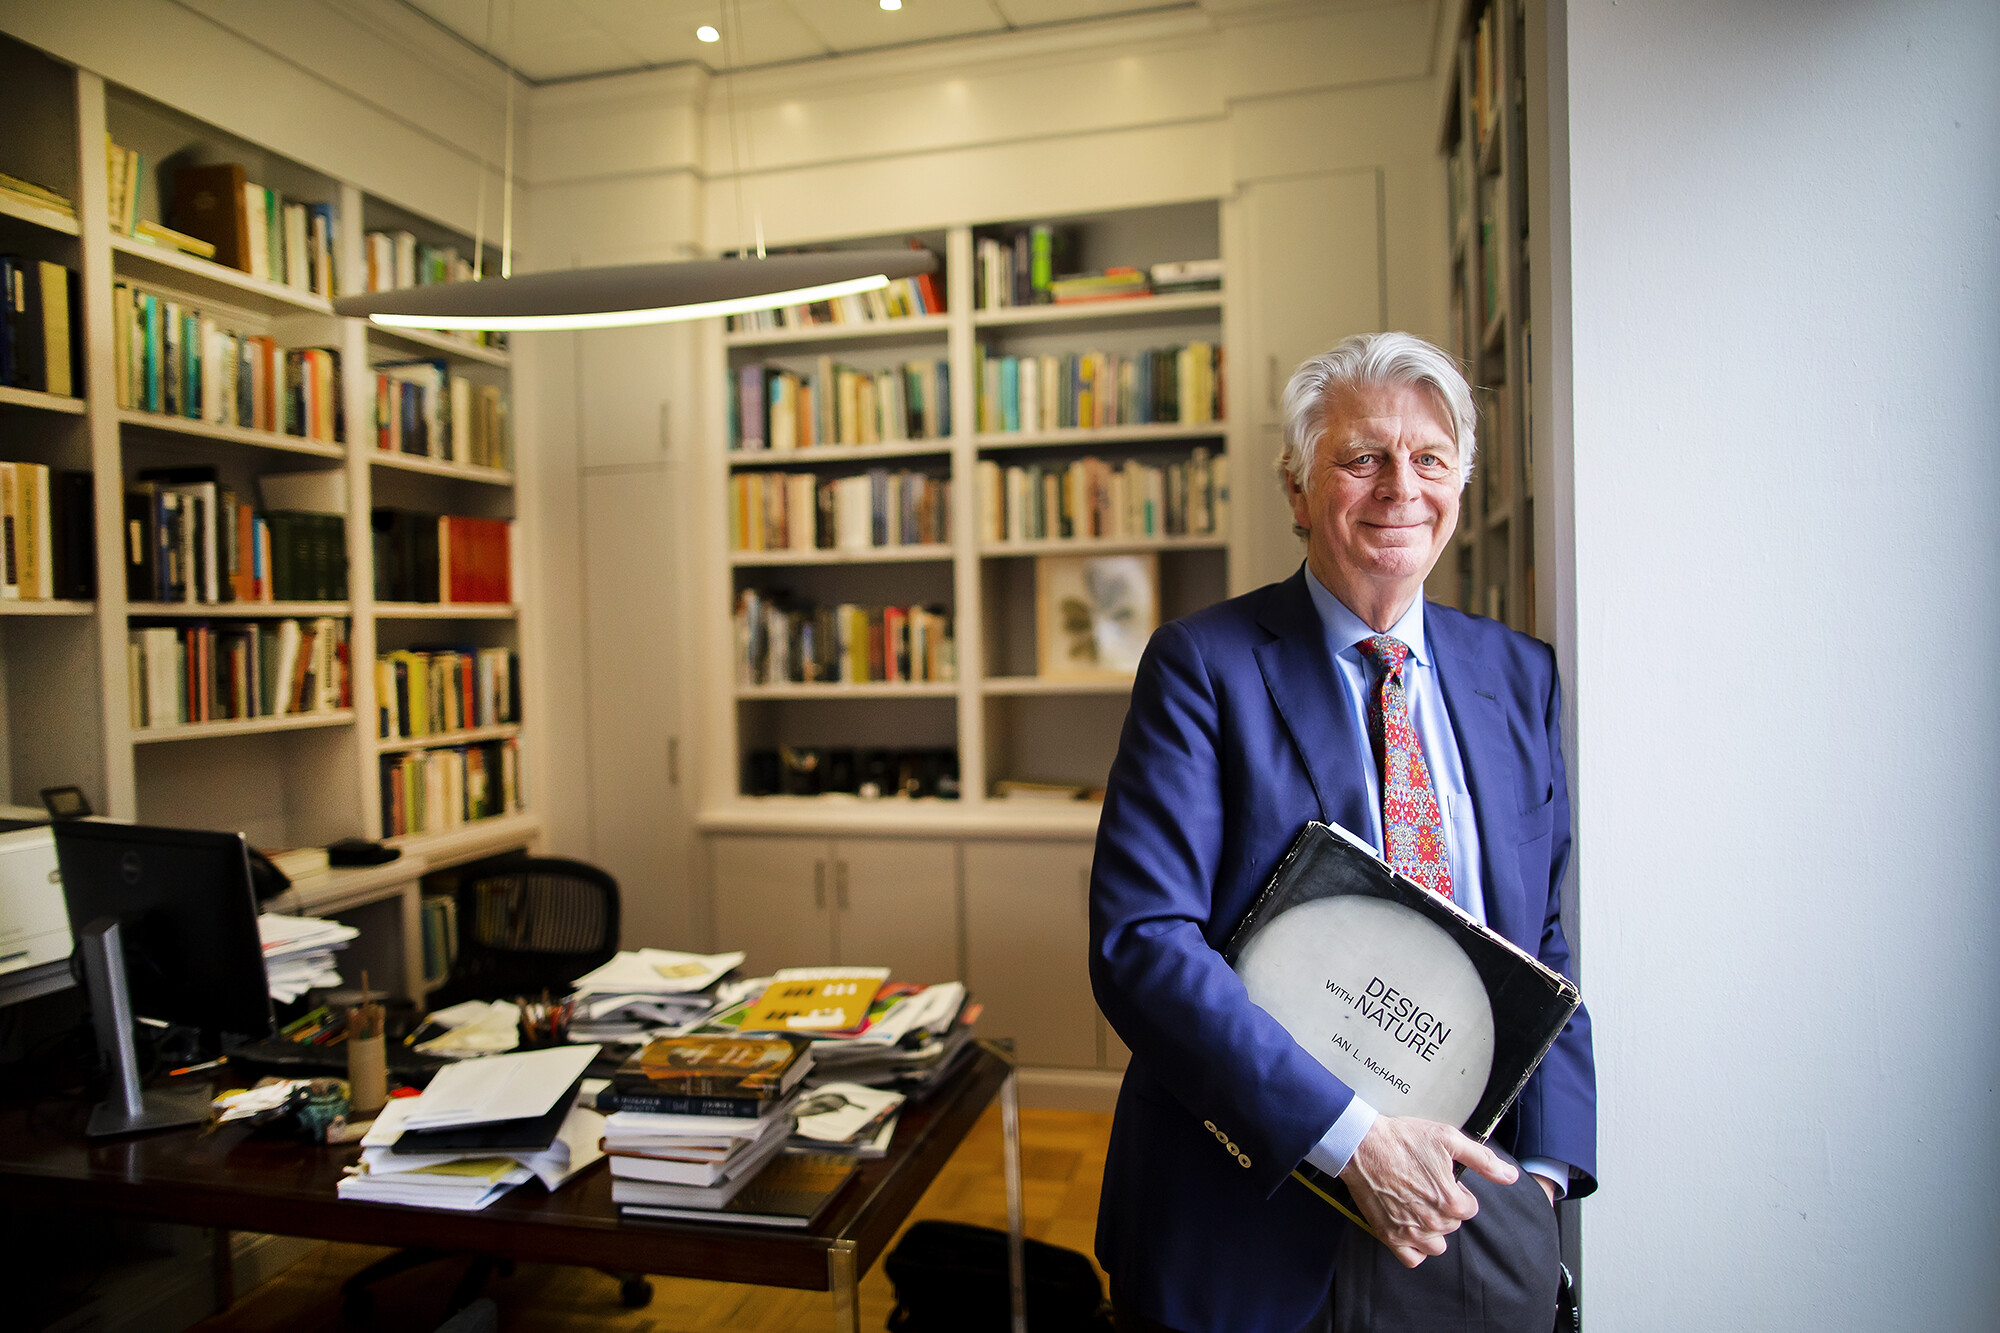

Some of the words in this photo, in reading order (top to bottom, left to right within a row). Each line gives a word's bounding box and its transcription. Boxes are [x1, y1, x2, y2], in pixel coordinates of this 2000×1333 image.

[1325, 979, 1354, 1005] WITH
[1353, 994, 1440, 1062] NATURE
[1365, 976, 1452, 1045] DESIGN
[1331, 1033, 1352, 1052] IAN
[1352, 1048, 1361, 1062] L.
[1363, 1057, 1411, 1095] McHARG
